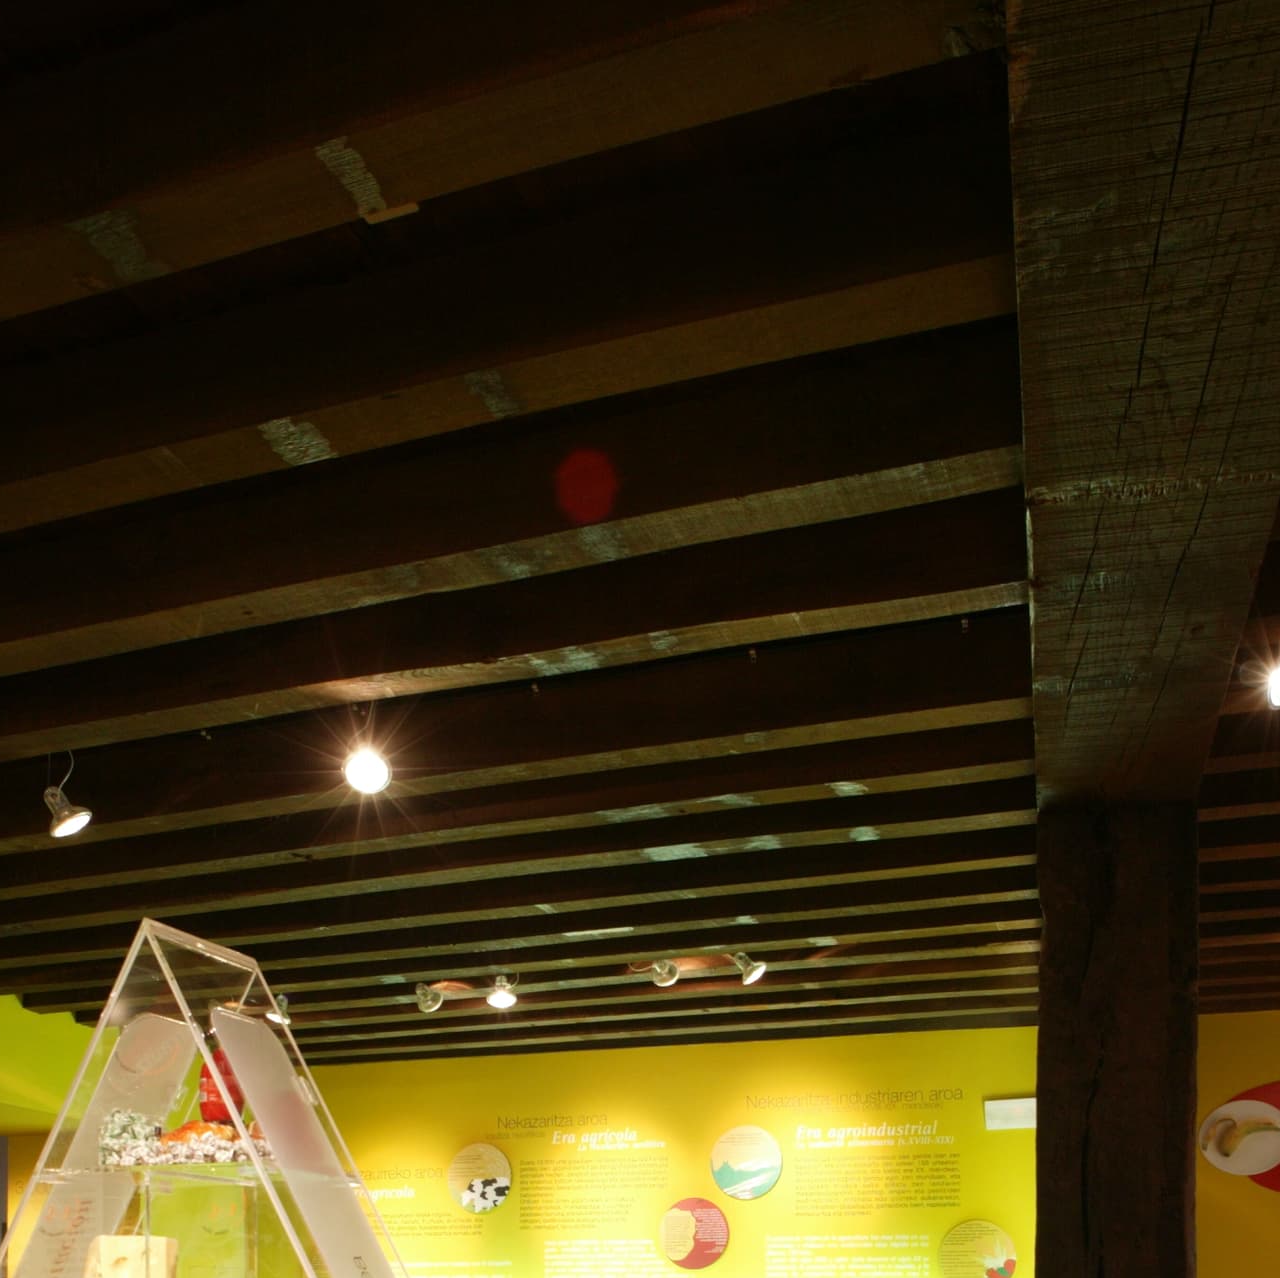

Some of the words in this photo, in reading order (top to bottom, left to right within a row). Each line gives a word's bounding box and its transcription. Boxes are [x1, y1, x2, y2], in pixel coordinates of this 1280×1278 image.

[928, 1087, 964, 1101] aroa
[496, 1113, 573, 1129] Nekazaritza
[551, 1130, 577, 1145] Era
[795, 1124, 822, 1140] Era
[827, 1119, 938, 1142] agroindustrial
